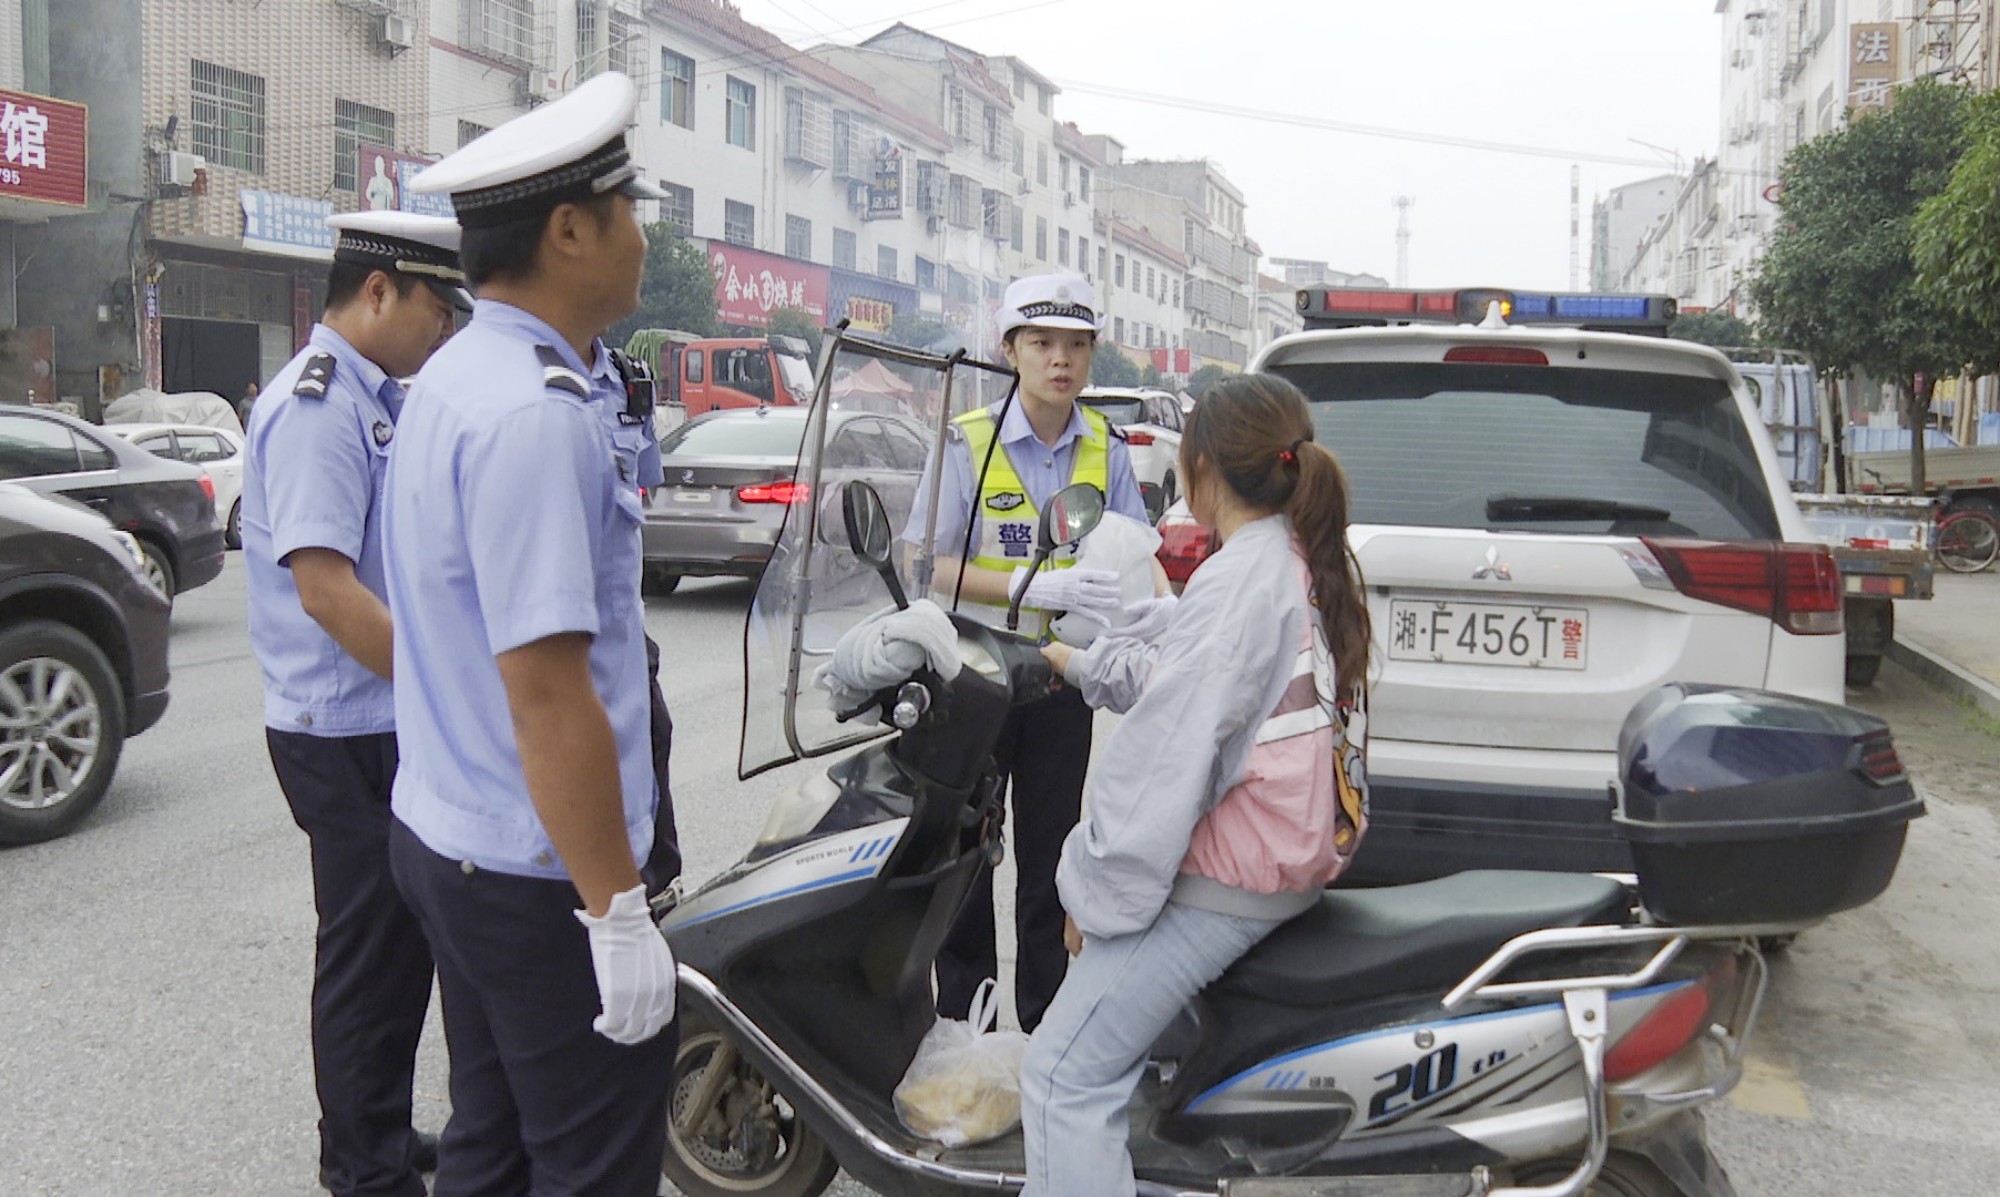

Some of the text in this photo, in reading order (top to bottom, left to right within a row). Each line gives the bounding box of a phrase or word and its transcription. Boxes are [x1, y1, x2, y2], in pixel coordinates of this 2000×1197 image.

[0, 102, 48, 169] 馆
[998, 523, 1032, 557] 警
[796, 853, 825, 866] SPORTS
[1367, 1041, 1460, 1121] 20
